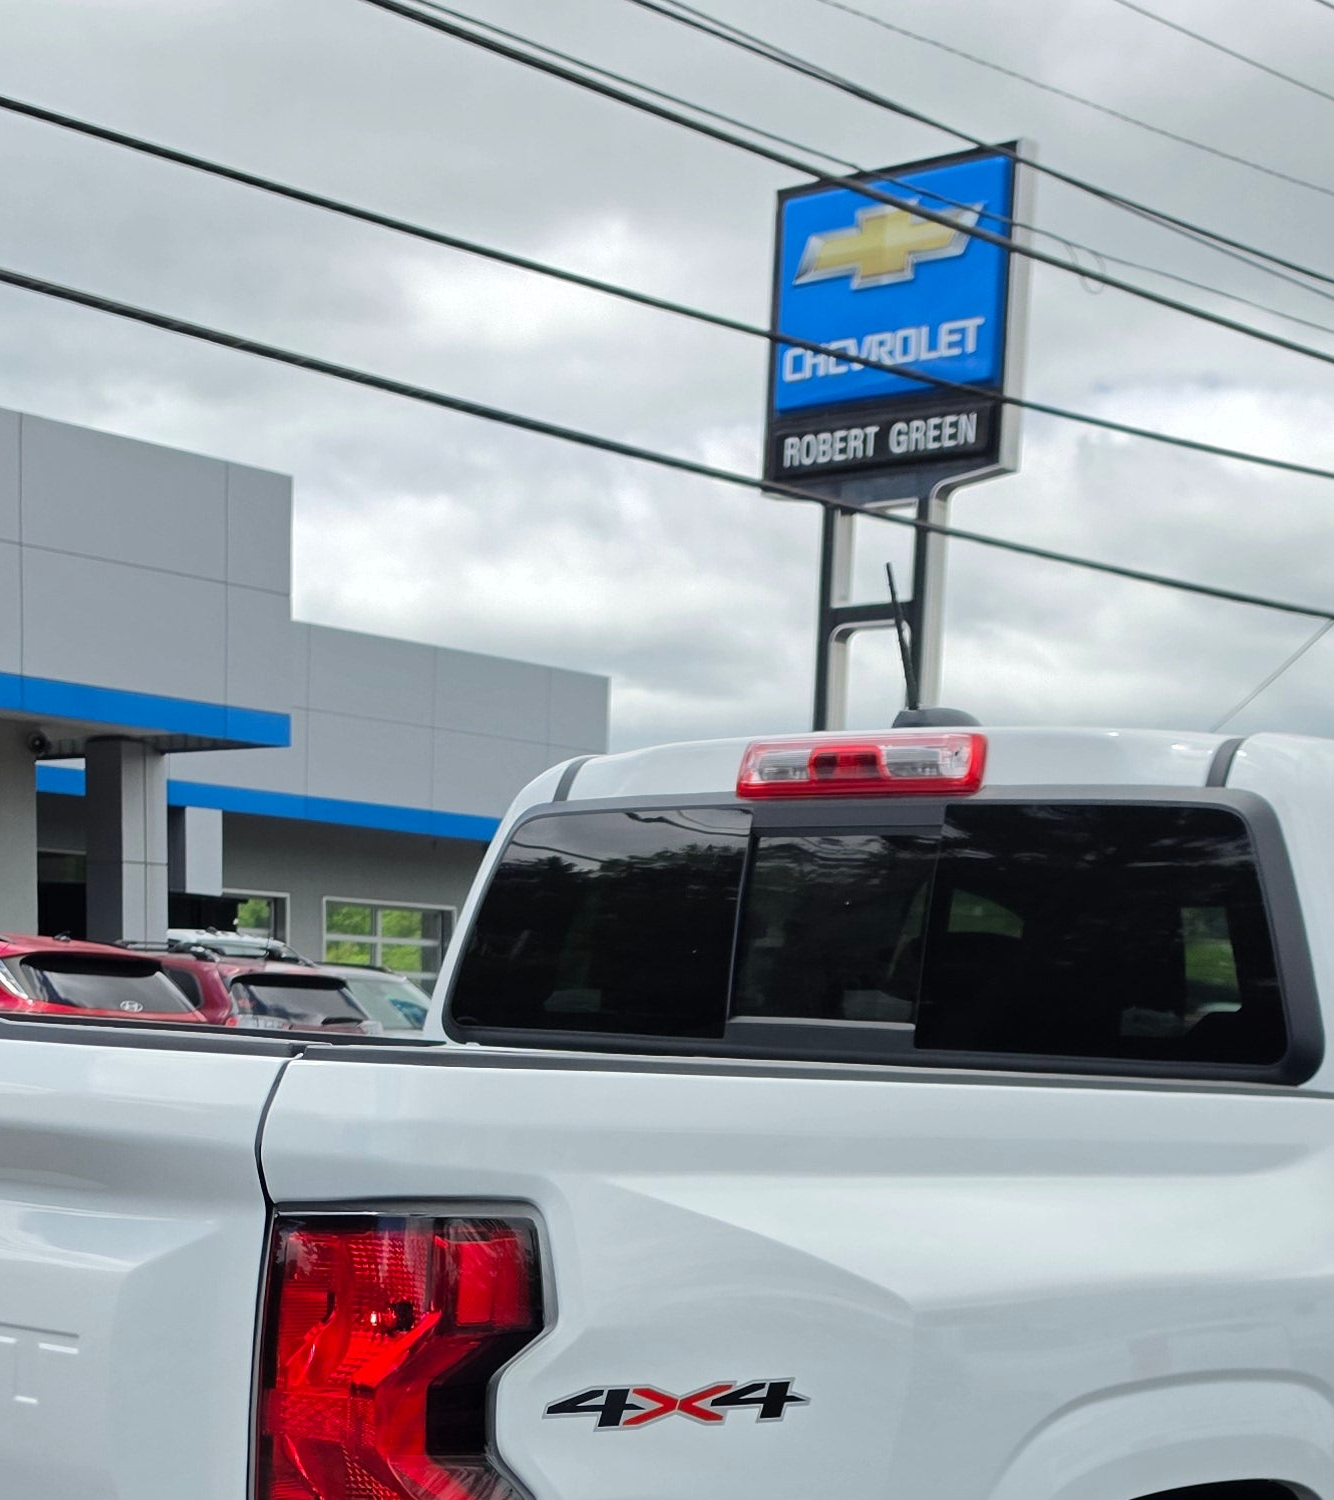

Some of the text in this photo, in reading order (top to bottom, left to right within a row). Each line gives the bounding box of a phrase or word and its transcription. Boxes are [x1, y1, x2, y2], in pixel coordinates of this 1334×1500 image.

[783, 316, 986, 383] CHEVROLET
[783, 411, 978, 469] ROBERT GREEN
